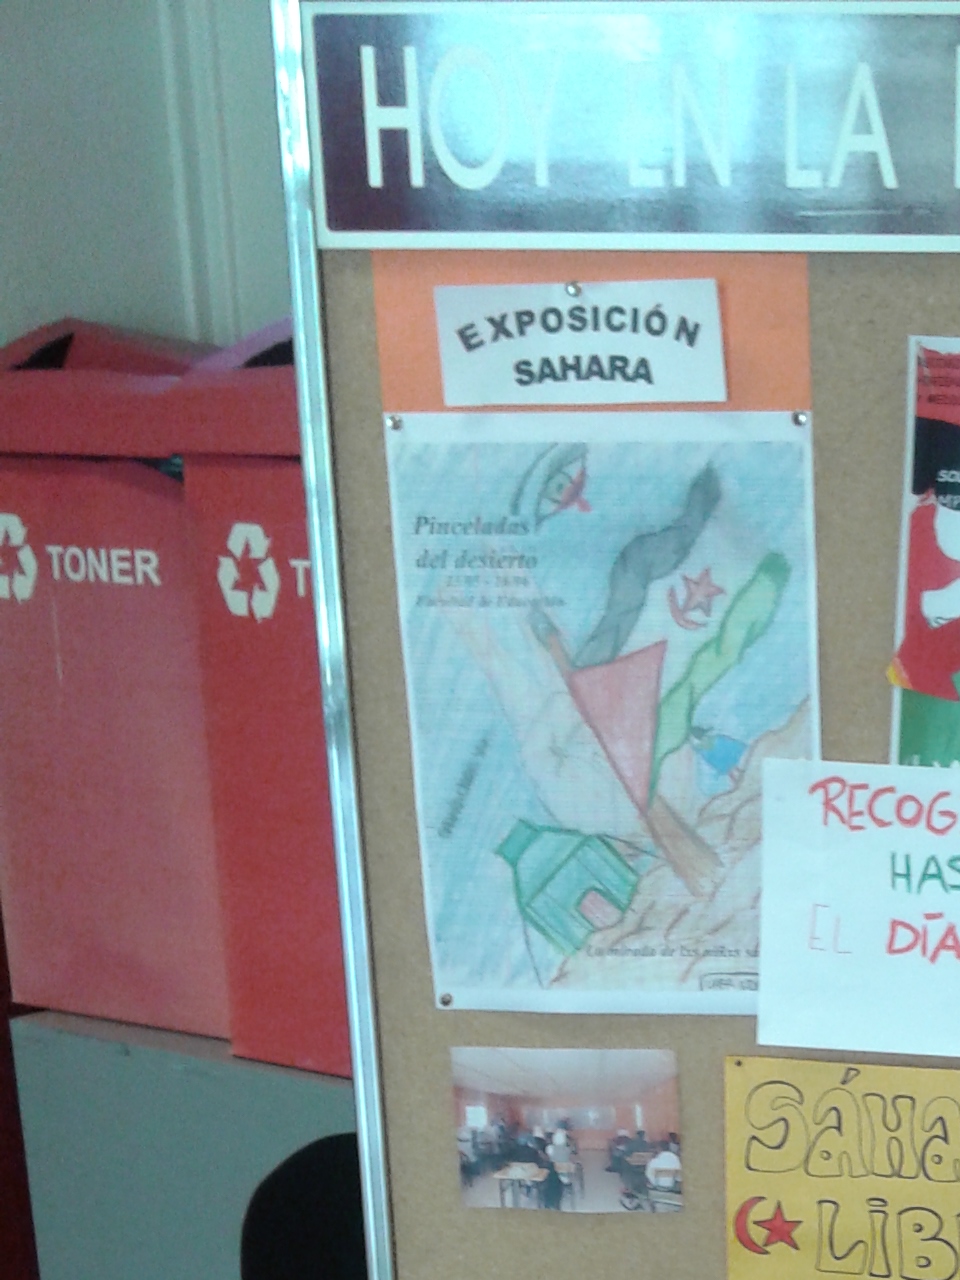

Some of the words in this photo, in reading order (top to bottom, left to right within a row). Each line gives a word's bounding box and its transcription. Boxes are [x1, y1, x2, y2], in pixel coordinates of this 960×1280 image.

[360, 44, 559, 191] HOY
[625, 60, 733, 189] EN
[785, 61, 899, 190] LA
[455, 303, 702, 353] EXPOSICIÓN
[513, 355, 655, 387] SAHARA
[415, 516, 530, 535] Pinceladas
[46, 545, 162, 587] TONER
[416, 549, 448, 569] del
[455, 549, 538, 569] desierto
[808, 903, 852, 954] EL
